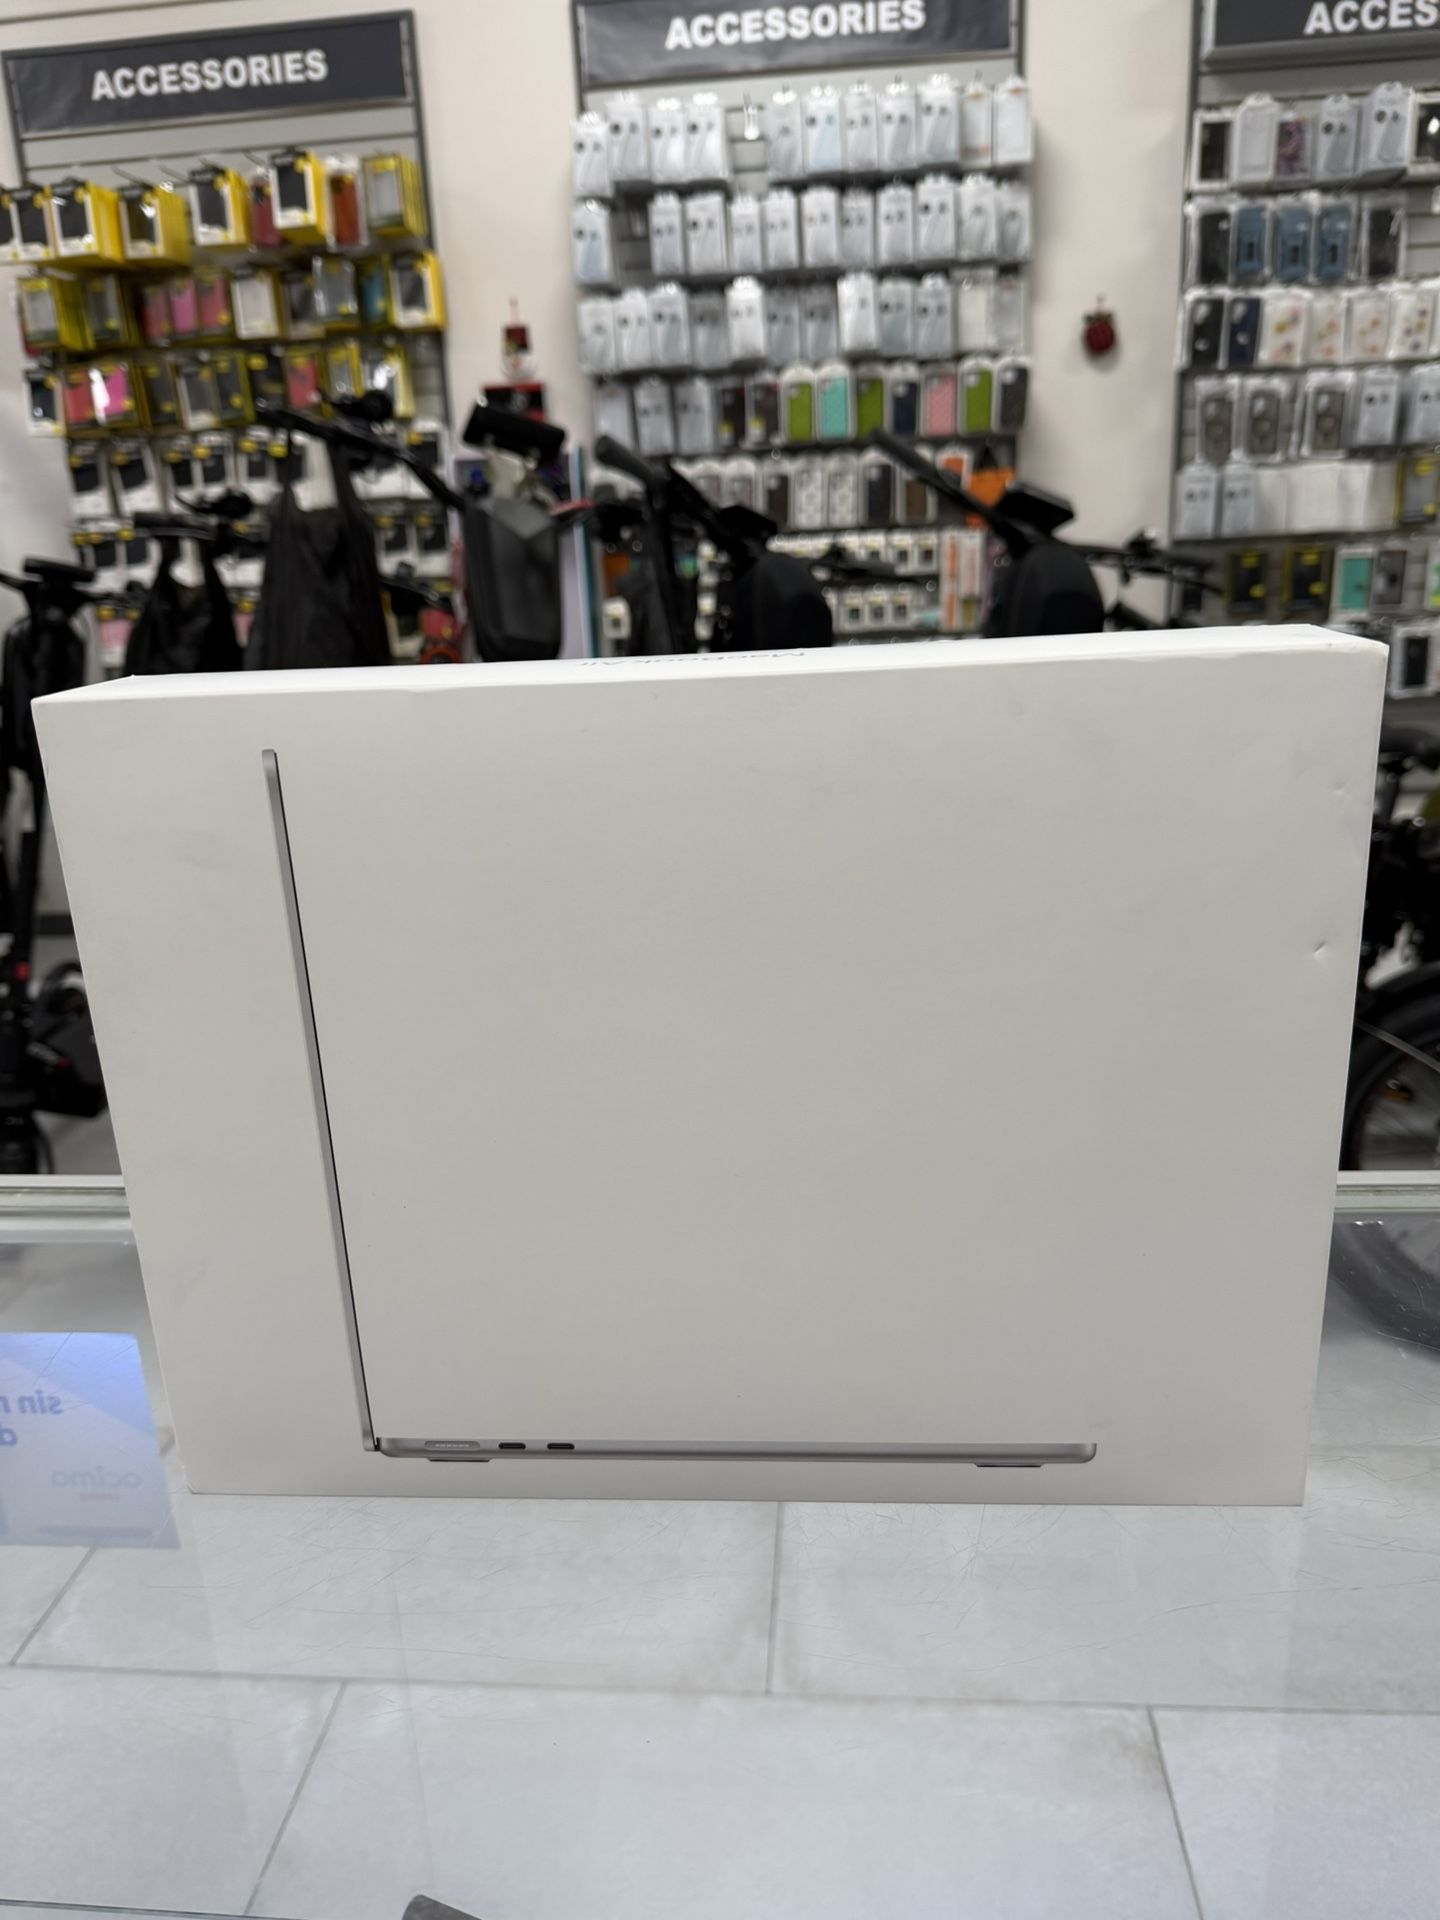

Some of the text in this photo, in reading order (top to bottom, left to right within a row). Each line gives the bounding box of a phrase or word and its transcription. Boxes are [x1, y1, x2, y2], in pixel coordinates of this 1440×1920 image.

[664, 0, 926, 50] ACCESSORIES
[1303, 0, 1439, 35] ACCES
[91, 49, 329, 101] ACCESSORIES
